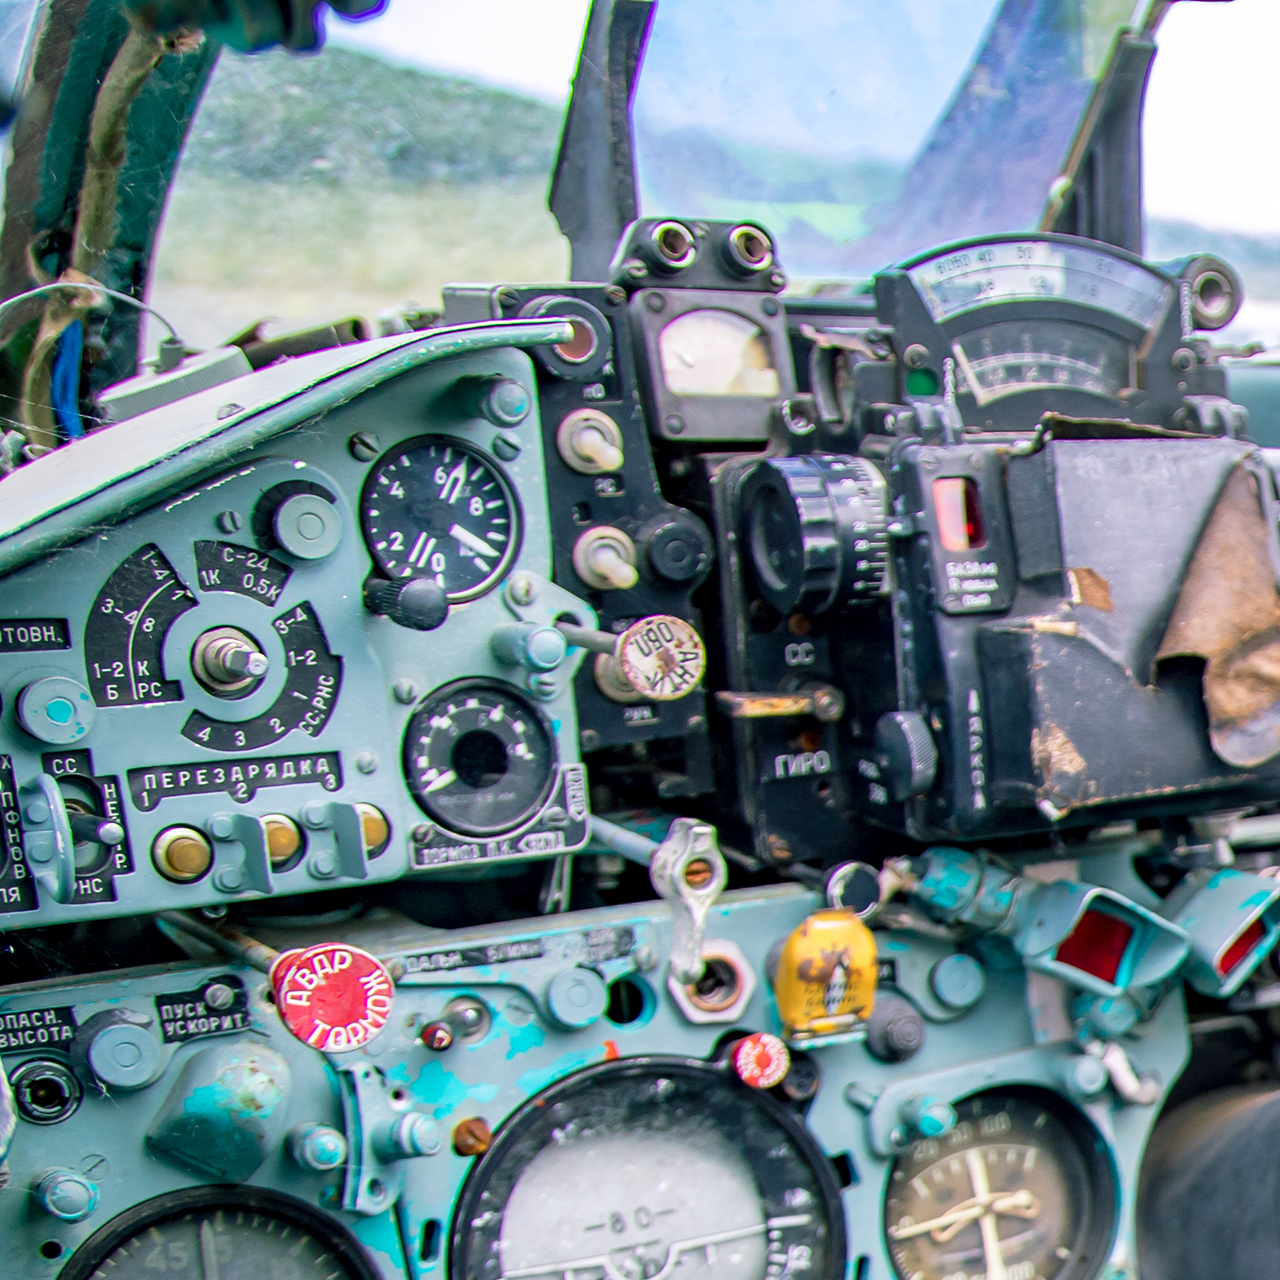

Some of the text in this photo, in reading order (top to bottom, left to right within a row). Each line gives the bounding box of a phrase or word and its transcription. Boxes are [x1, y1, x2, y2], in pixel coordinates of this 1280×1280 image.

[434, 467, 447, 484] 6
[389, 481, 404, 499] 4
[470, 497, 484, 516] 8
[389, 531, 404, 550] 2
[431, 552, 445, 572] 0
[143, 618, 155, 632] 8
[0, 626, 63, 643] ТОВН.
[290, 651, 317, 665] 1-2
[94, 662, 124, 678] 1-2
[107, 685, 118, 700] Б
[269, 718, 285, 733] 2
[197, 727, 212, 742] 4
[234, 731, 246, 746] 3
[52, 758, 77, 774] СС
[143, 757, 330, 790] ПЕРЕЗАРЯДКА
[142, 774, 337, 807] 1 2 3
[103, 783, 128, 869] НЕР.
[74, 878, 103, 894] НС
[160, 1001, 208, 1020] ПУСК
